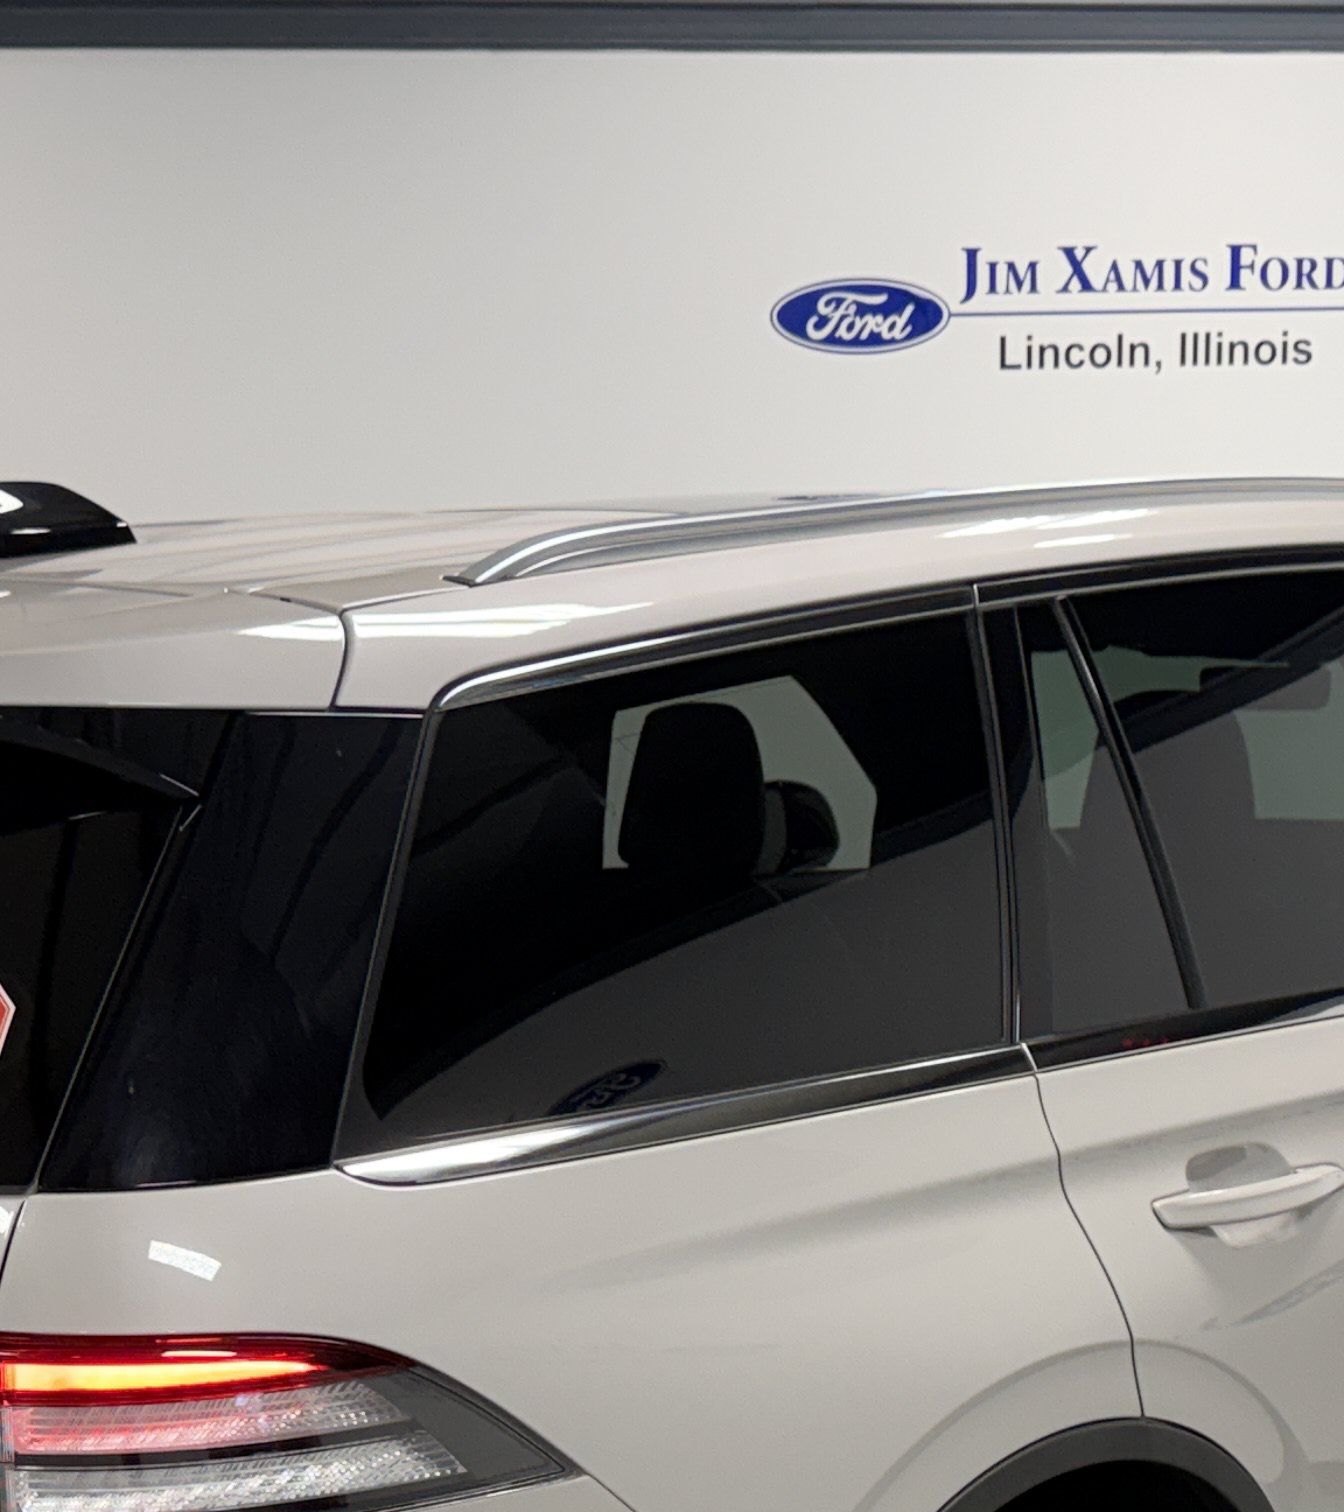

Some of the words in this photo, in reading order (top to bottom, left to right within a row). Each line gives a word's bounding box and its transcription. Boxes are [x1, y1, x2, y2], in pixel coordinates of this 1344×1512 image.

[961, 246, 1040, 303] JIM
[1056, 245, 1209, 295] XAMIS
[999, 333, 1163, 375] Lincoln,
[1179, 331, 1314, 368] Illinois
